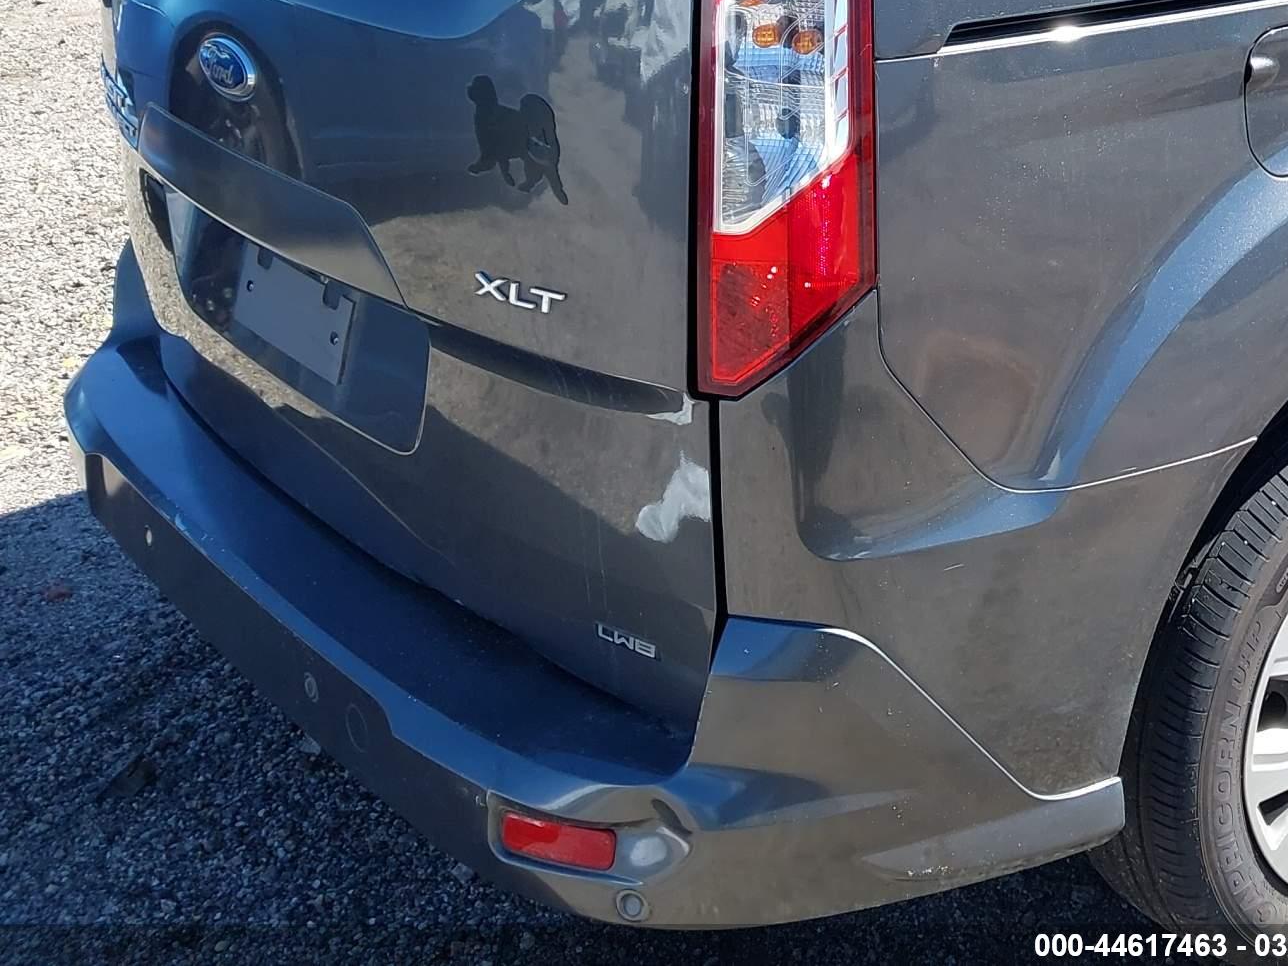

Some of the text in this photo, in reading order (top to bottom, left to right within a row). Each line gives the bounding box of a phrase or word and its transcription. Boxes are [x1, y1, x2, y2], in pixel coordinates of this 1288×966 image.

[474, 272, 567, 314] XLT
[597, 624, 657, 659] LWB
[1213, 700, 1277, 923] CAPRICORN
